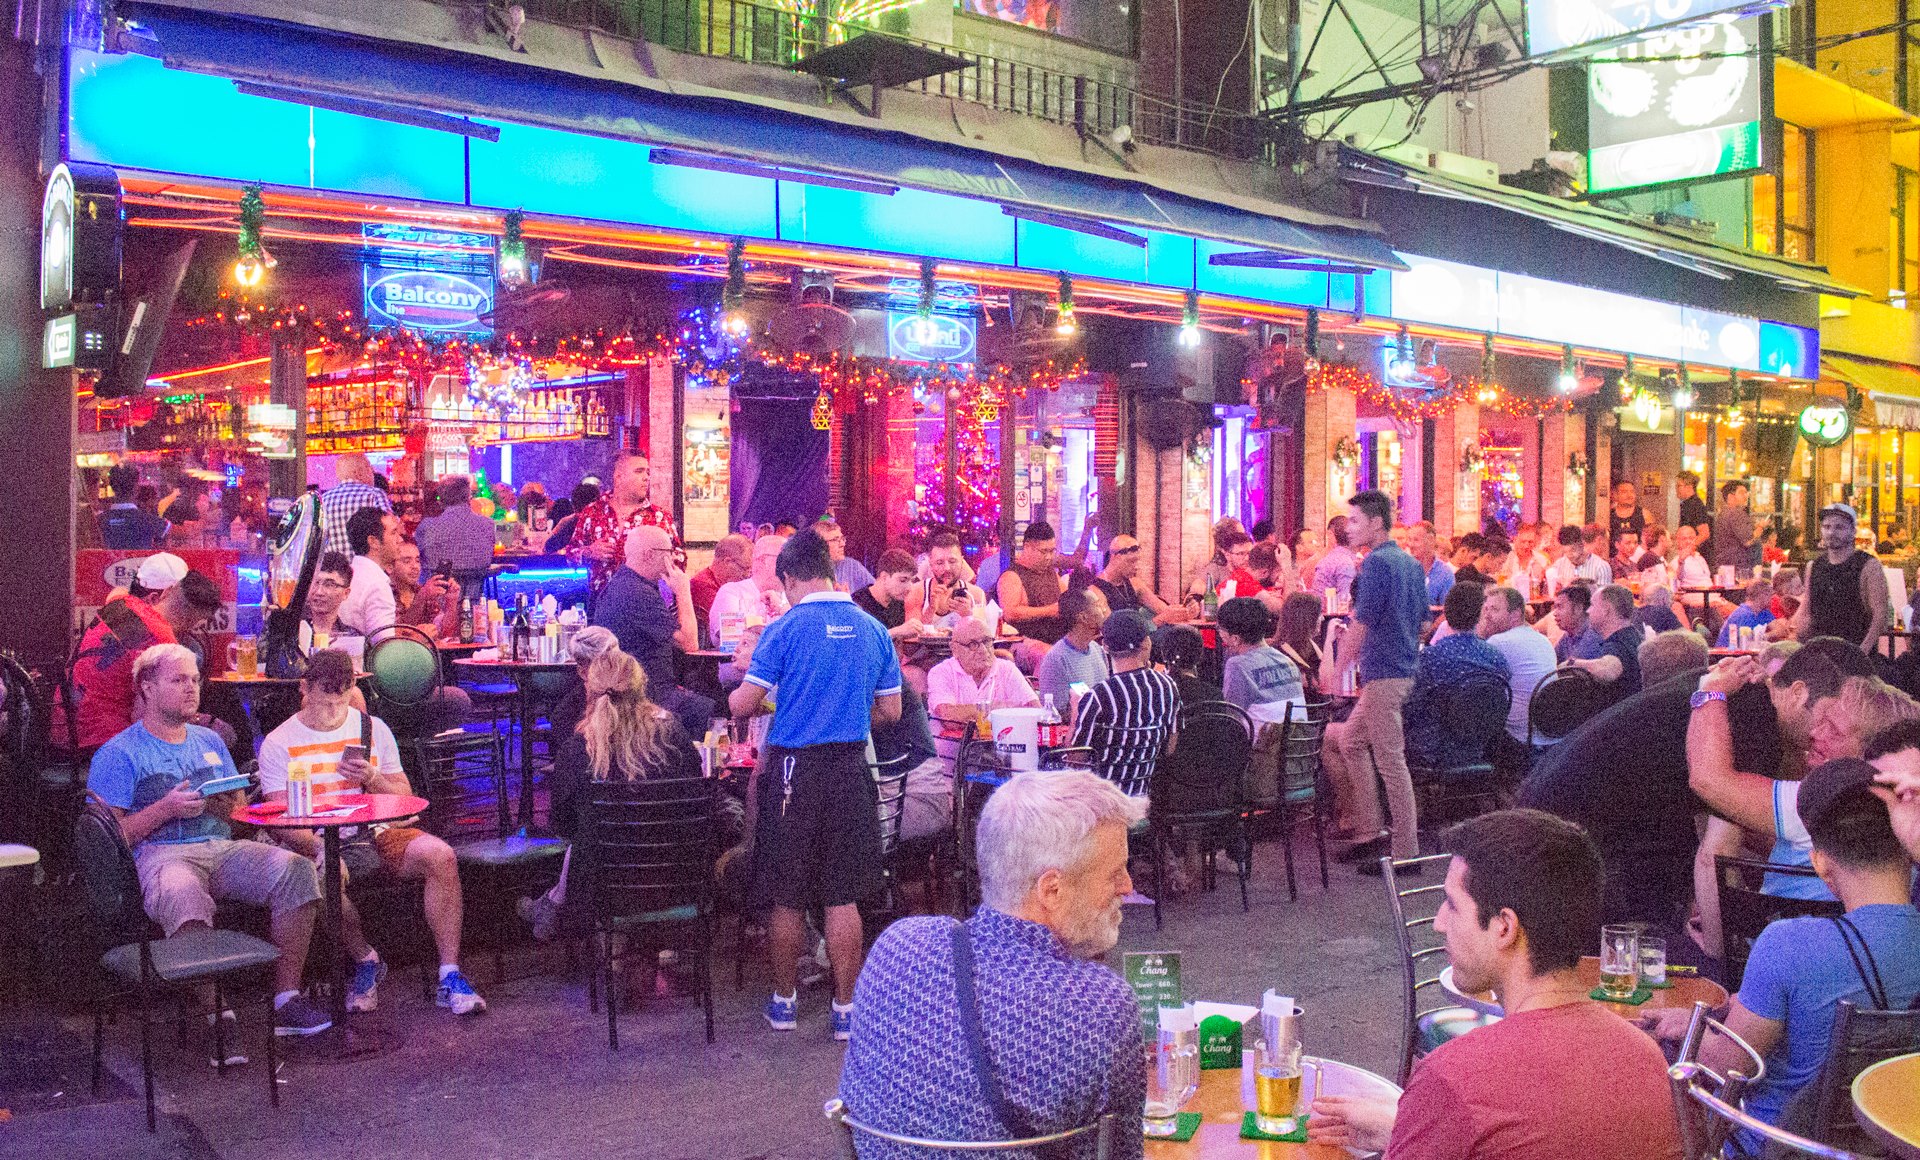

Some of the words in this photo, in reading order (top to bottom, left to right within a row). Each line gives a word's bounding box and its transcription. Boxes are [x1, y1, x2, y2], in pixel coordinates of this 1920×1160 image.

[384, 283, 481, 310] Balcony
[385, 301, 405, 314] The
[1140, 966, 1168, 975] Chang
[1203, 1044, 1232, 1053] Chang
